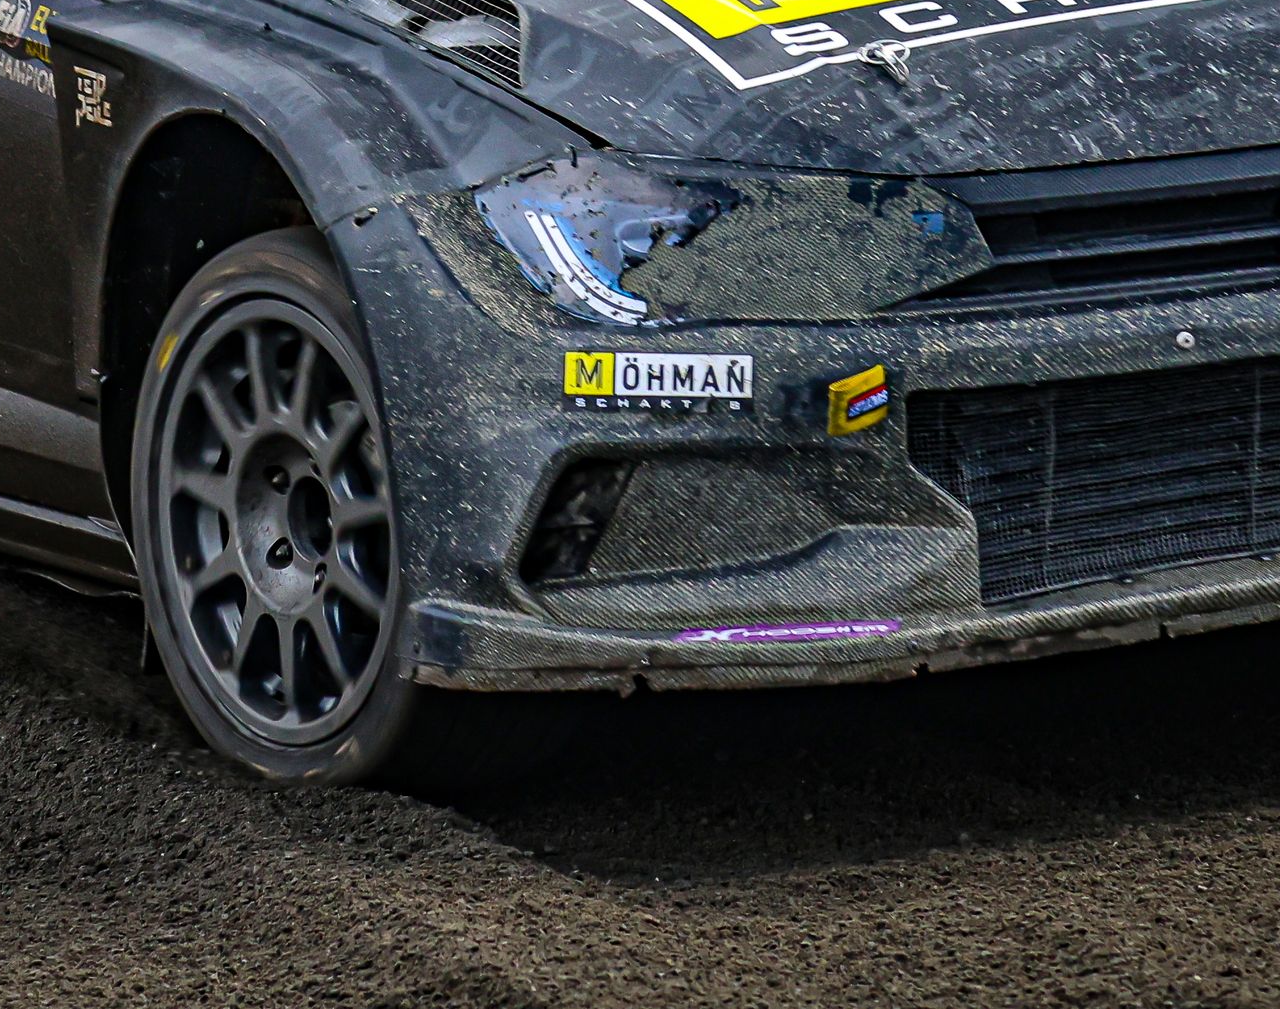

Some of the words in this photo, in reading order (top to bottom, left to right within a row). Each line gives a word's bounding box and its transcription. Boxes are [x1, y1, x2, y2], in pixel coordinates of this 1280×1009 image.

[576, 359, 603, 390] M
[623, 357, 746, 394] ÖHMAN
[575, 398, 694, 410] SCHAKT
